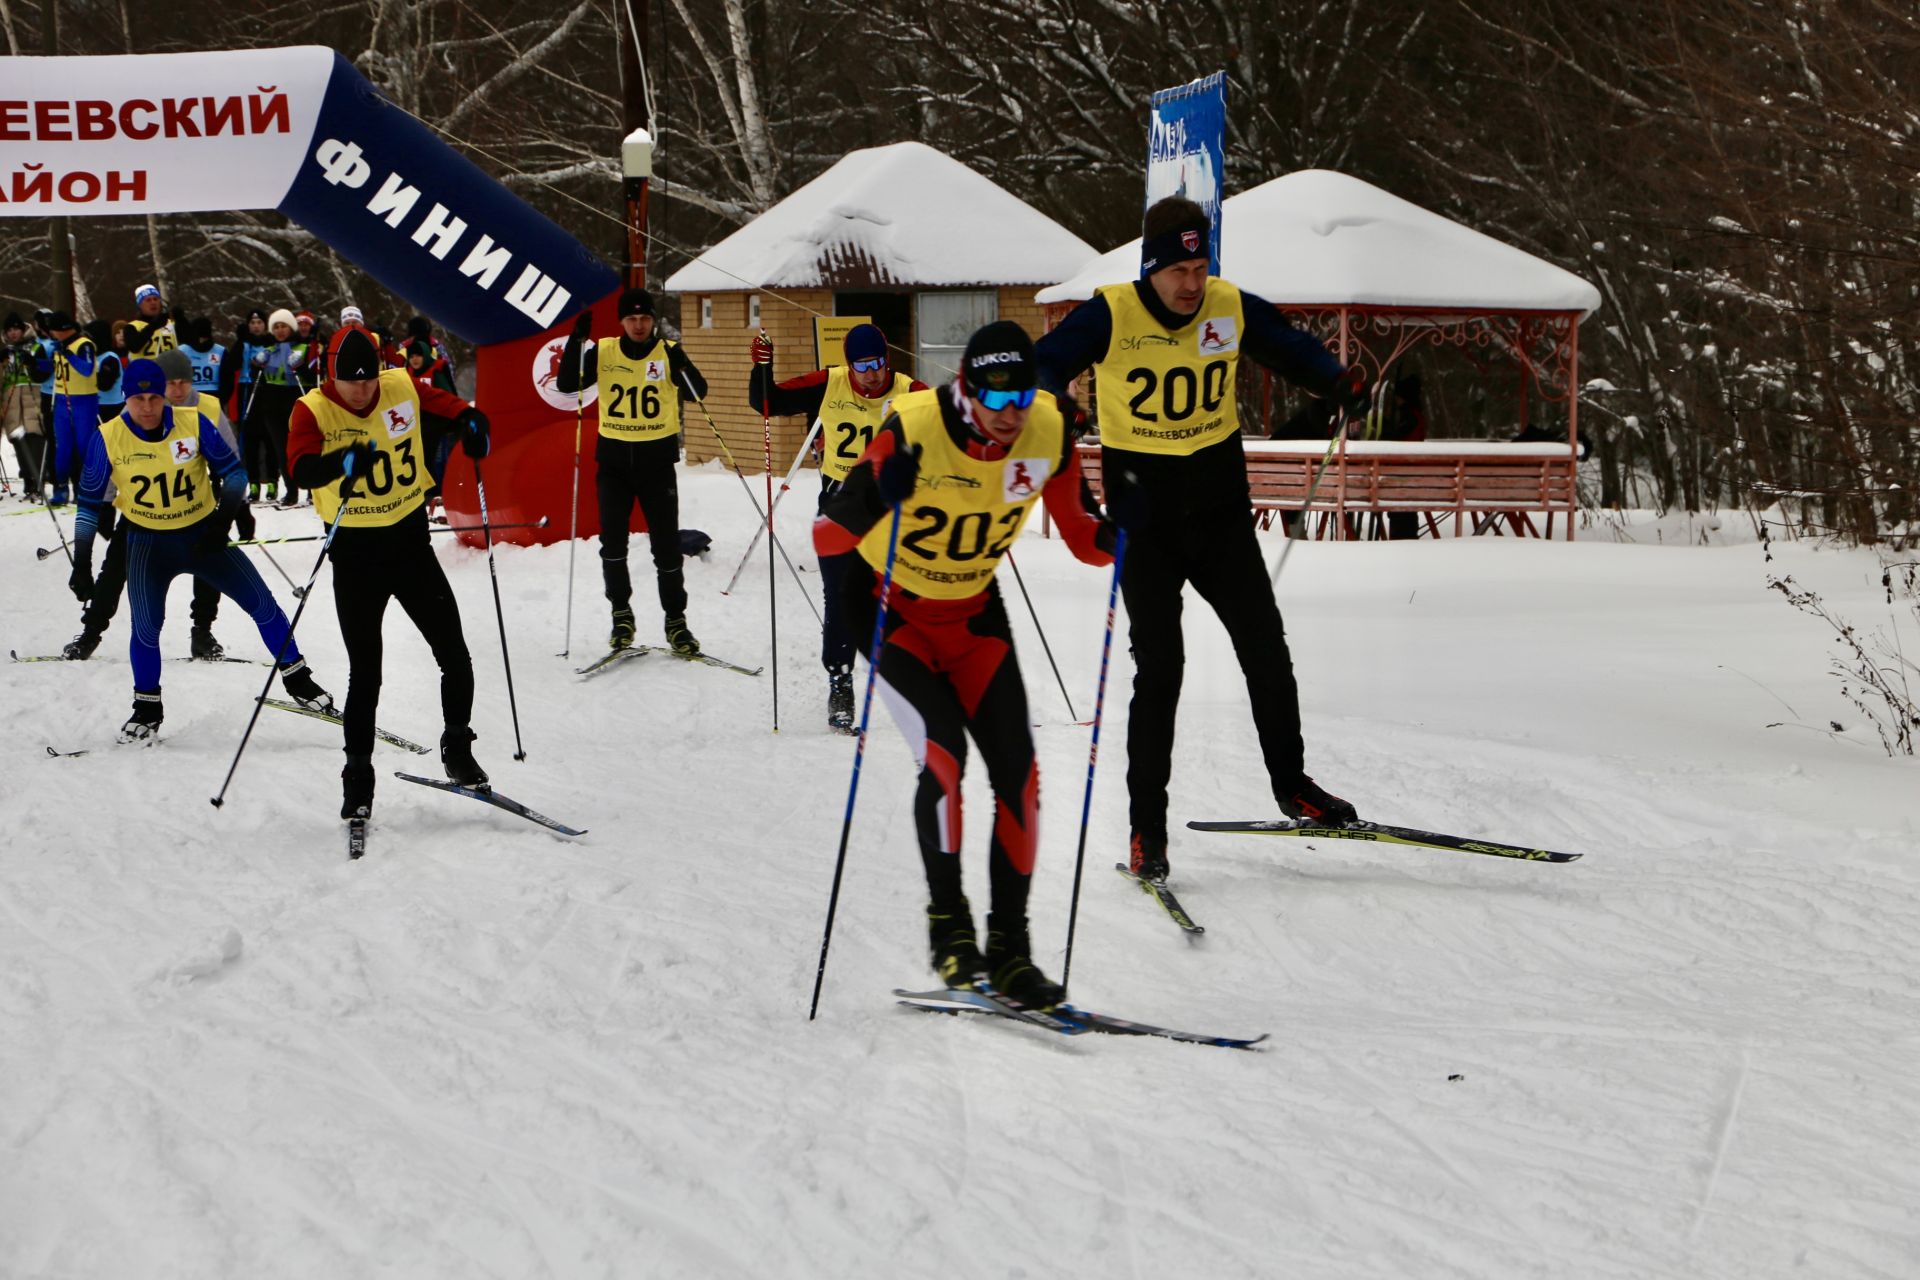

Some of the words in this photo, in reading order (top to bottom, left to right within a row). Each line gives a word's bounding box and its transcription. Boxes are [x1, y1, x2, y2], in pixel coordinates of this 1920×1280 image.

[0, 85, 291, 142] ЕЕВСКИЙ
[316, 138, 572, 329] ФИНИШ
[971, 351, 1023, 368] LUKOIL
[608, 383, 660, 419] 216
[1126, 360, 1228, 422] 200
[130, 468, 196, 508] 214
[901, 506, 1024, 561] 202
[1299, 829, 1378, 842] FISCHER
